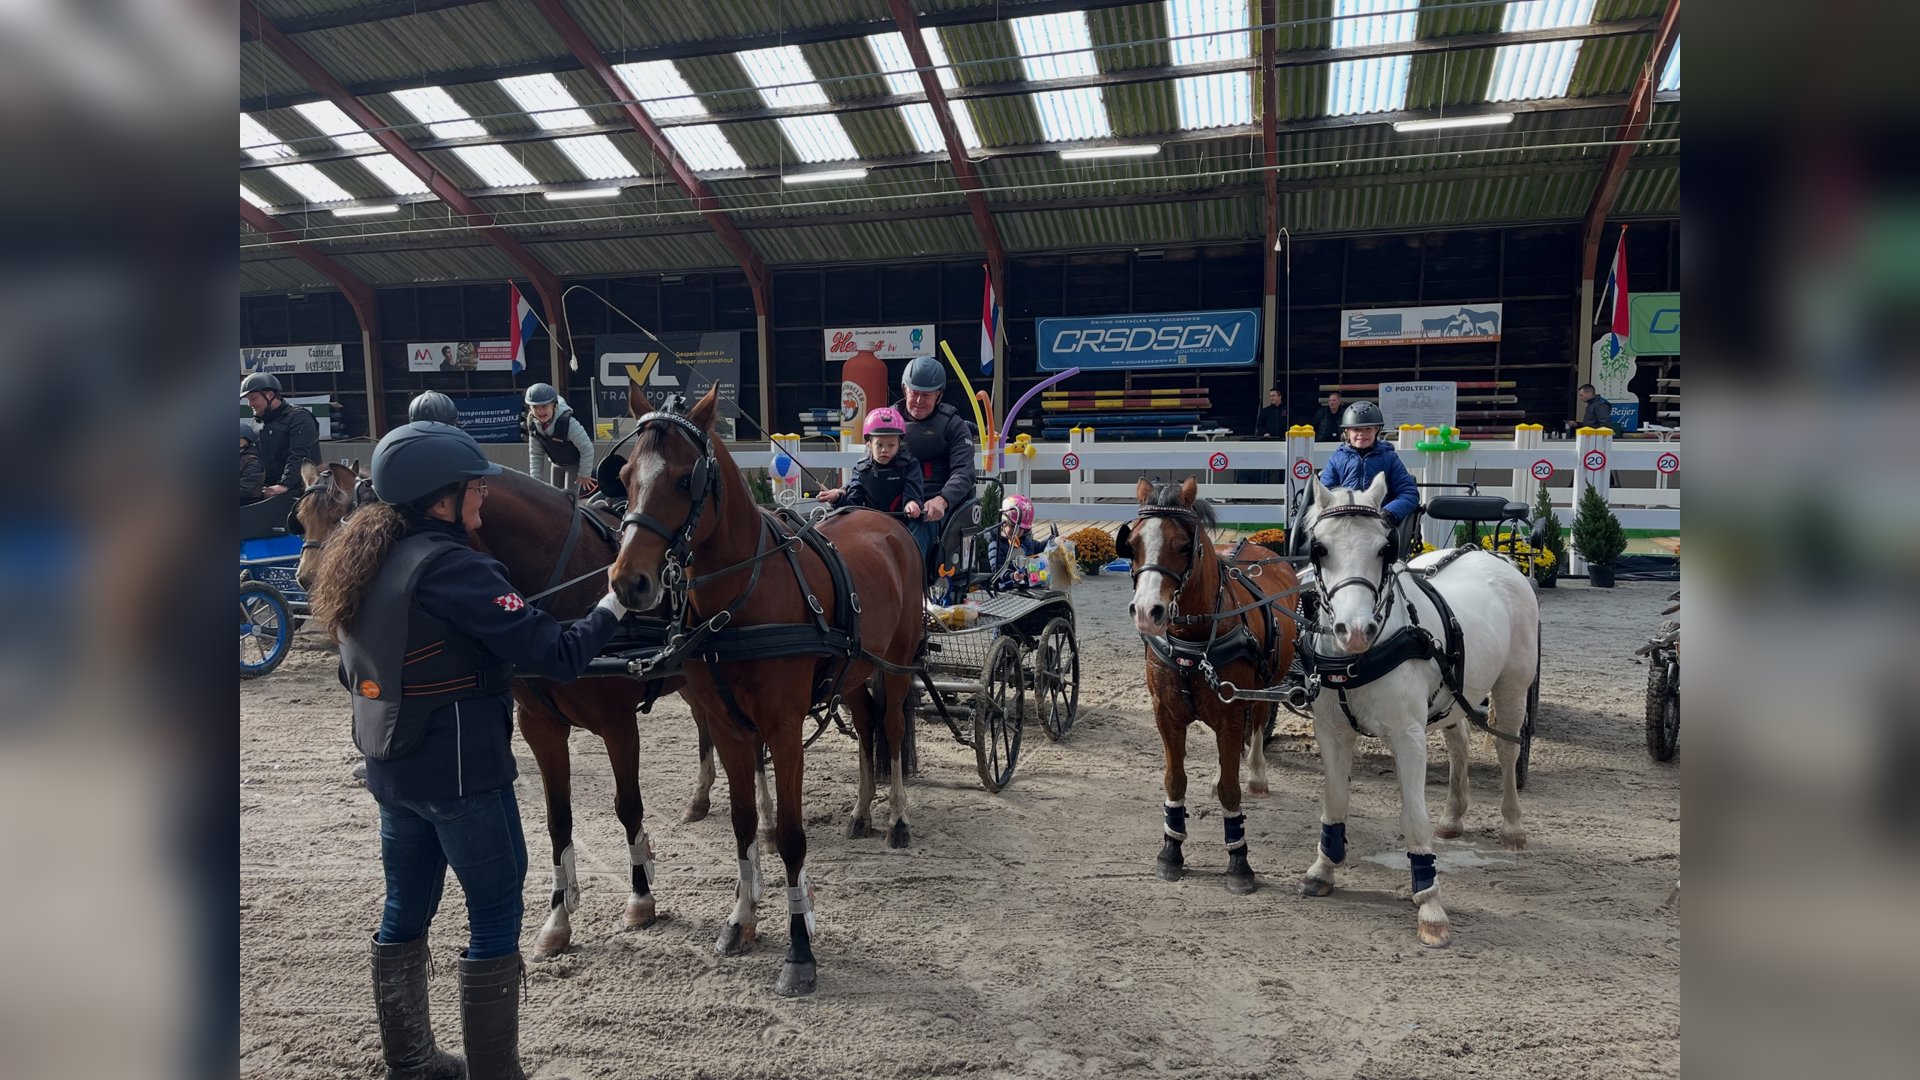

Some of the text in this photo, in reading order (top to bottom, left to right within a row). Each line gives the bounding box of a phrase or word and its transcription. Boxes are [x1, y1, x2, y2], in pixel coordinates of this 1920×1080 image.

[1052, 322, 1241, 353] CRSDSGN
[600, 352, 680, 387] CVL
[1395, 384, 1450, 392] POOLTECHNICK
[601, 391, 683, 401] TRAPORT
[1610, 406, 1636, 418] Beijer
[1065, 458, 1077, 466] 20
[1213, 458, 1226, 467] 20
[1587, 456, 1603, 466] 20
[1660, 459, 1676, 468] 20
[1296, 466, 1310, 474] 20
[1535, 466, 1550, 475] 20
